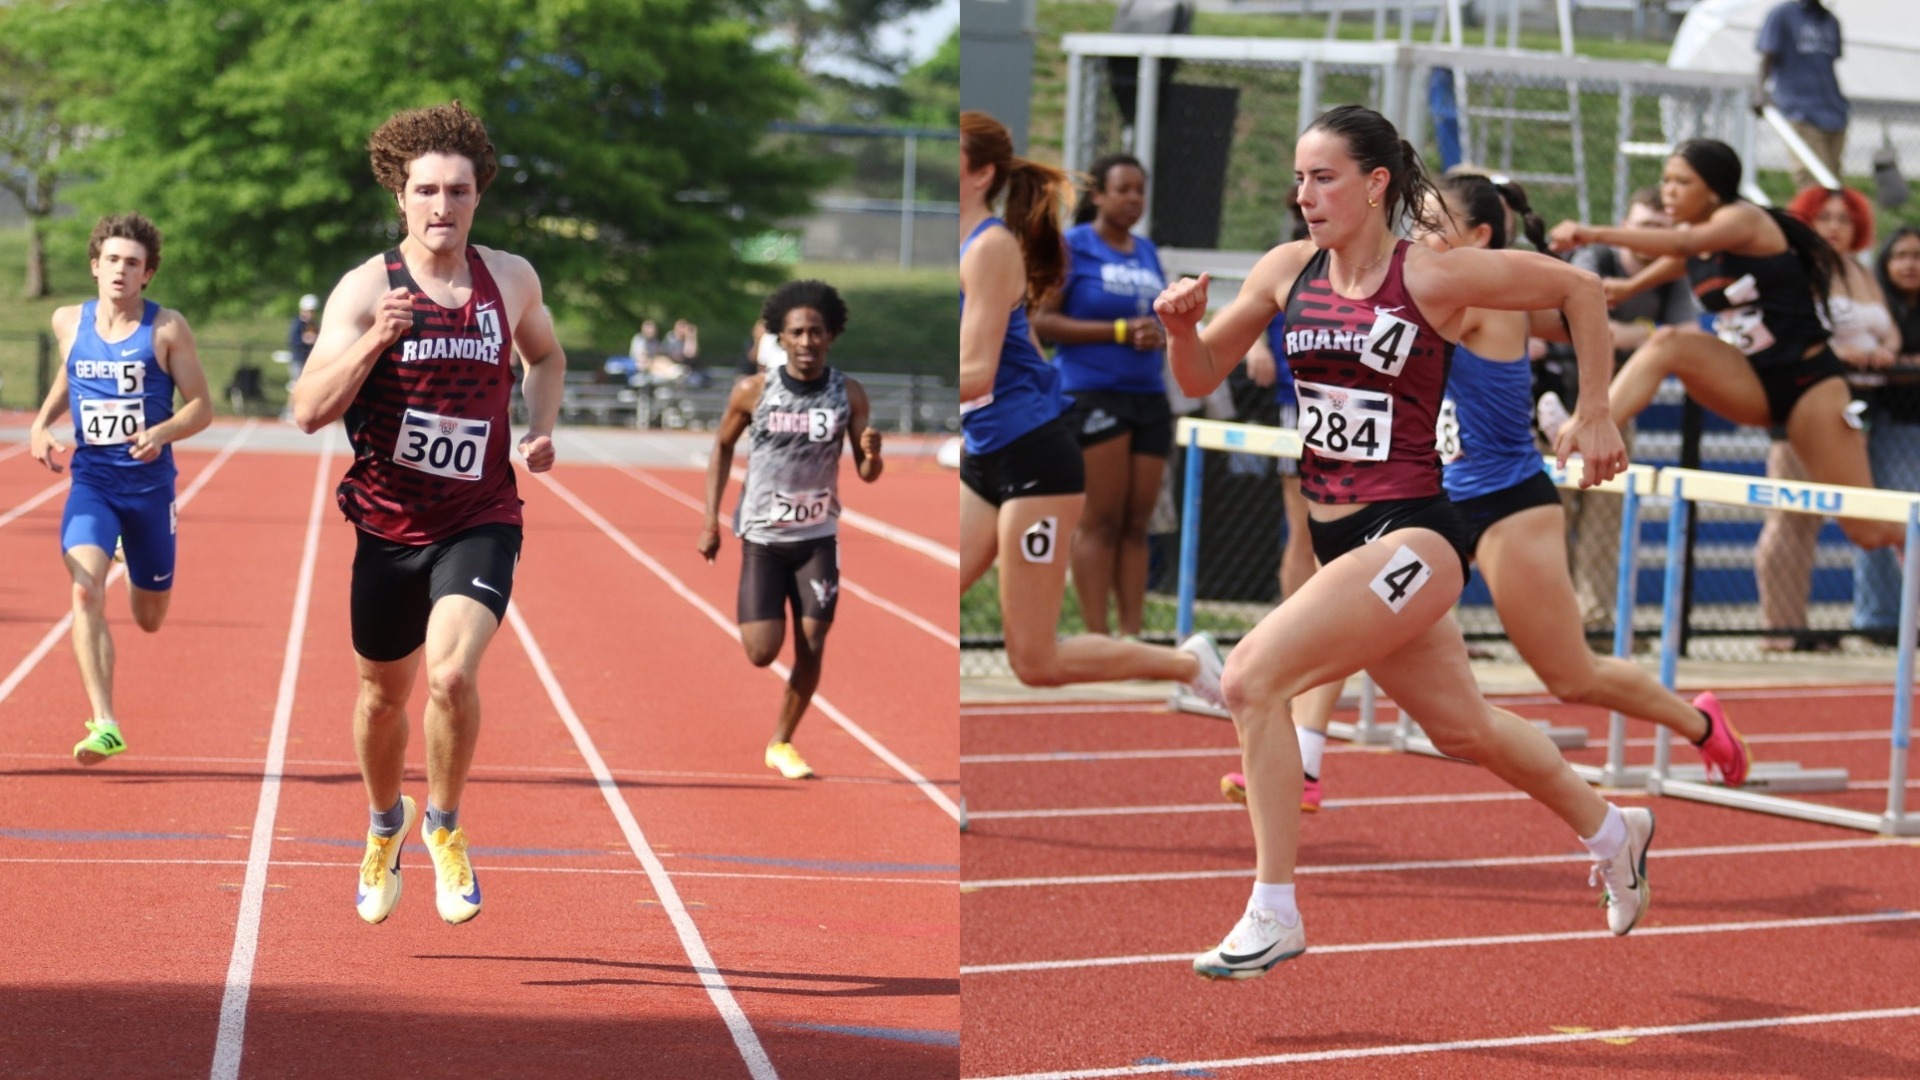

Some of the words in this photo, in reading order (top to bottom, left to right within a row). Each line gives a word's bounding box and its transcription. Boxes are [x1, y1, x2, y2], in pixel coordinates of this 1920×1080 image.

[482, 313, 496, 343] 4
[1286, 328, 1371, 356] ROANO
[401, 337, 500, 366] ROANOKE
[1371, 321, 1407, 370] 4
[123, 364, 137, 393] 5
[87, 414, 137, 438] 470
[814, 411, 828, 439] 3
[1305, 405, 1379, 457] 284
[401, 431, 477, 473] 300
[778, 502, 823, 522] 200
[1748, 483, 1842, 512] EMU
[1384, 560, 1424, 604] 4
